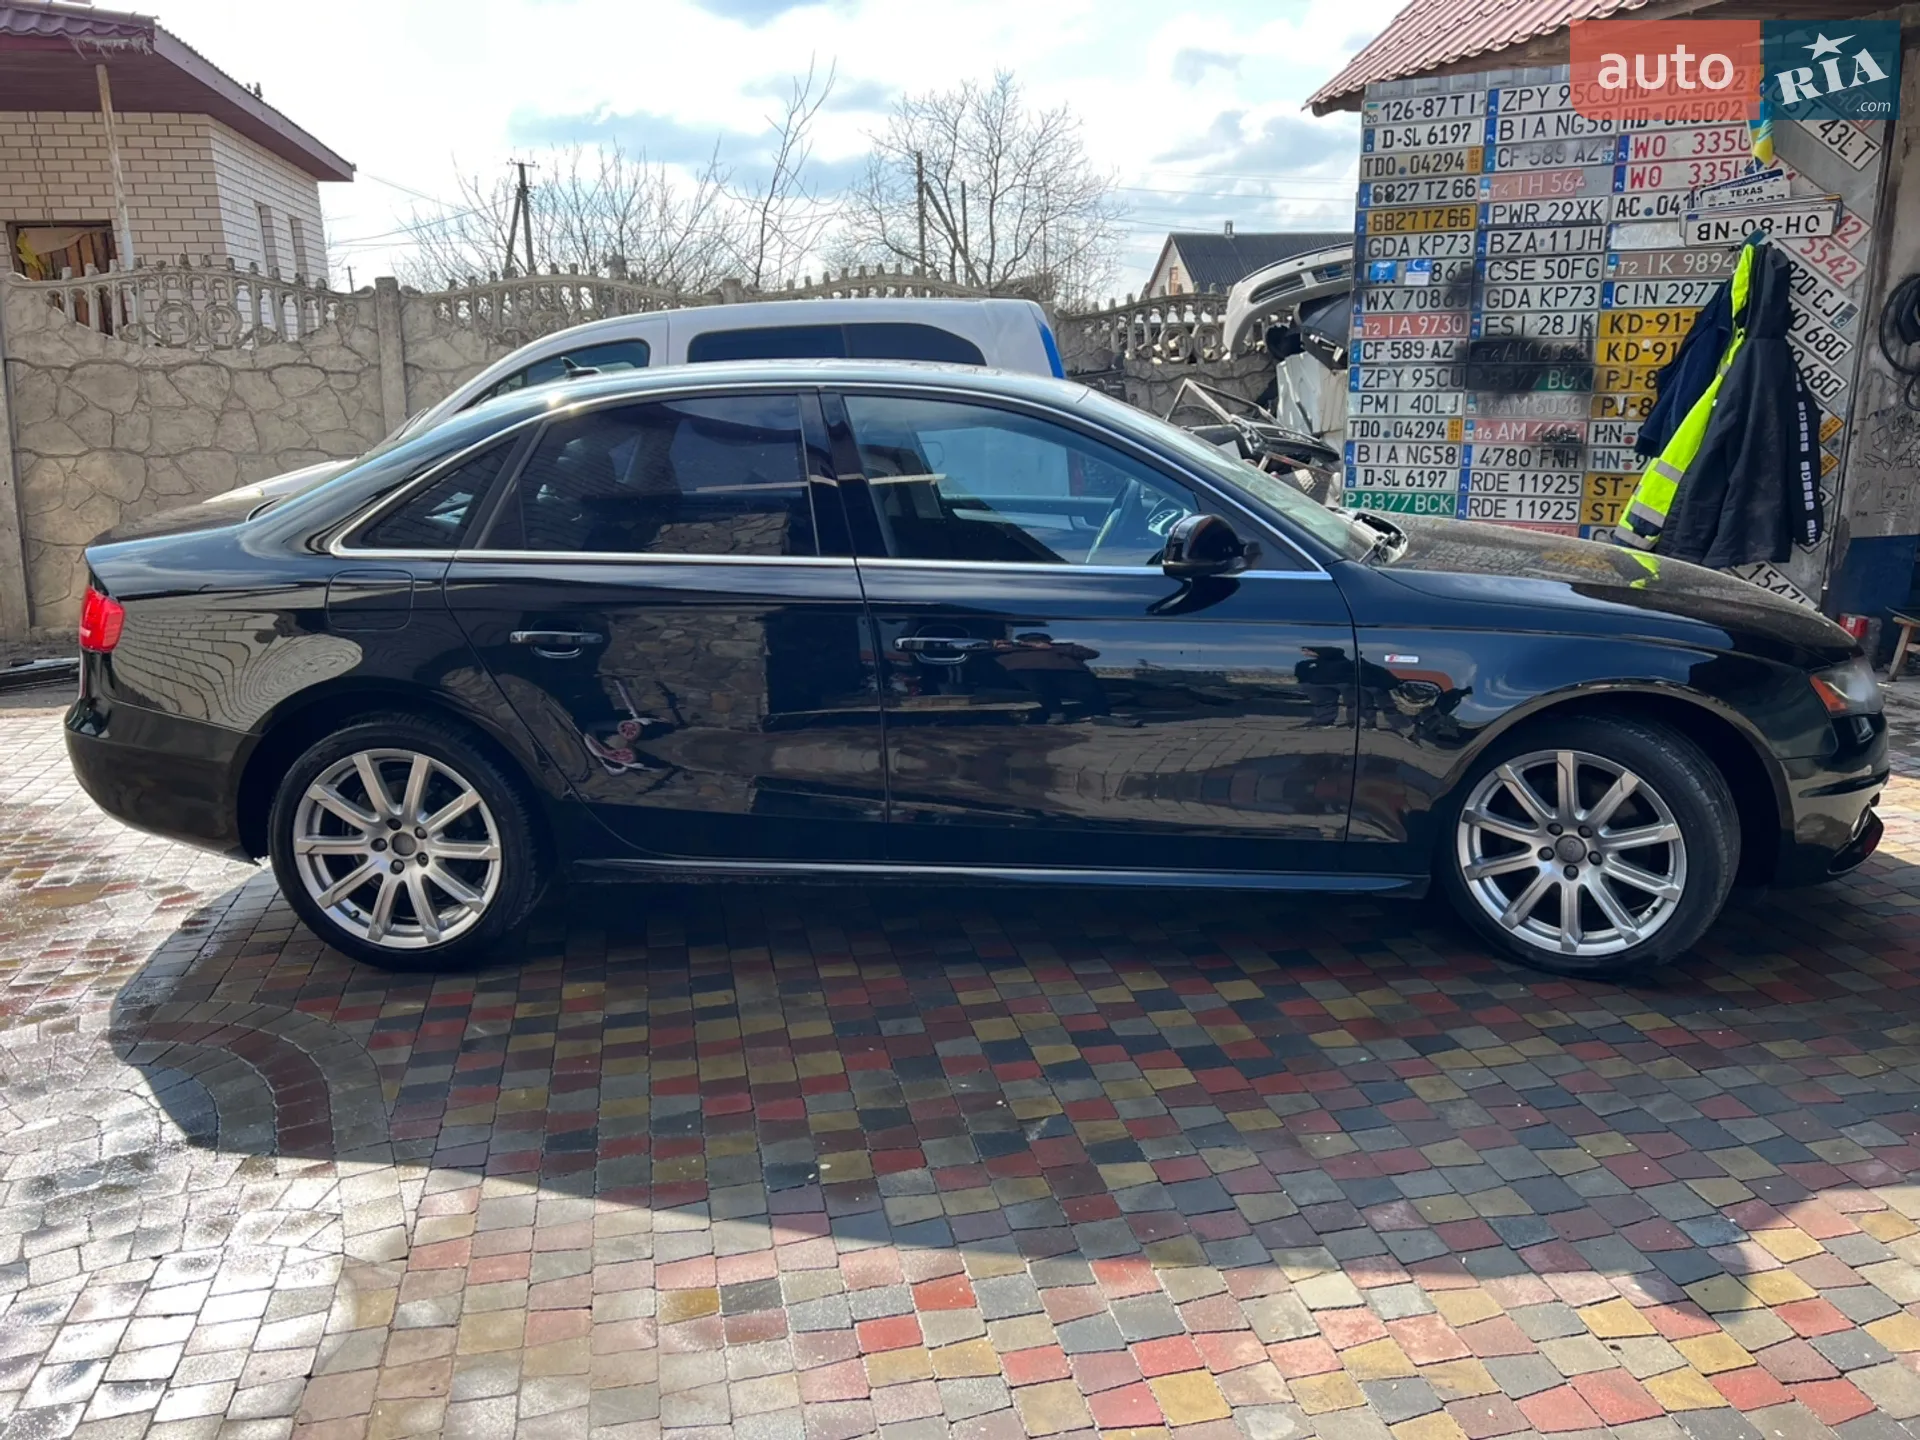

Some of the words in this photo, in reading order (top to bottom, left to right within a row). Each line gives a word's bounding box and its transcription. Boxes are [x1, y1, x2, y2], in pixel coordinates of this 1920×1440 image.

[1502, 86, 1550, 112] ZPY
[1559, 83, 1616, 106] 95CU
[1624, 108, 1648, 129] HD
[1665, 100, 1743, 126] 045092
[1382, 127, 1421, 148] D-SL
[1427, 123, 1471, 145] 6197
[1500, 116, 1546, 141] BIA
[1556, 111, 1612, 136] NG58
[1364, 157, 1396, 176] TDO
[1410, 152, 1464, 174] 04294
[1373, 183, 1419, 203] 6827
[1425, 181, 1447, 199] TZ
[1453, 178, 1476, 198] 66
[1518, 175, 1543, 196] IH
[1730, 186, 1764, 198] TEXAS
[1492, 203, 1540, 224] PWR
[1547, 200, 1603, 220] 29XK
[1616, 197, 1641, 217] AC
[1369, 236, 1410, 257] GDA
[1419, 234, 1471, 256] KP73
[1490, 232, 1537, 253] BZA
[1550, 228, 1603, 251] 11JH
[1489, 260, 1536, 281] CSE
[1543, 258, 1599, 279] 50FG
[1619, 261, 1638, 274] T2
[1648, 254, 1675, 274] IK
[1366, 291, 1394, 310] WX
[1486, 288, 1531, 308] GDA
[1540, 286, 1595, 307] KP73
[1616, 284, 1658, 304] CIN
[1364, 323, 1380, 335] T2
[1389, 316, 1411, 334] IA
[1418, 316, 1462, 334] 9730
[1485, 316, 1525, 336] ESI
[1362, 369, 1404, 388] ZPY
[1412, 368, 1463, 387] 95CU
[1361, 395, 1398, 413] PMI
[1410, 395, 1459, 413] 40LJ
[1350, 421, 1380, 438] TDO
[1393, 421, 1445, 438] 04294
[1476, 428, 1492, 439] 16
[1496, 423, 1526, 440] AM
[1357, 444, 1398, 463] BIA
[1407, 446, 1456, 464] NG58
[1479, 447, 1531, 466] 4780
[1539, 450, 1577, 468] FNH
[1363, 469, 1400, 486] D-SL
[1406, 470, 1447, 487] 6197
[1470, 472, 1509, 491] RDE
[1518, 473, 1579, 494] 11925
[1468, 498, 1507, 518] RDE
[1516, 500, 1577, 520] 11925
